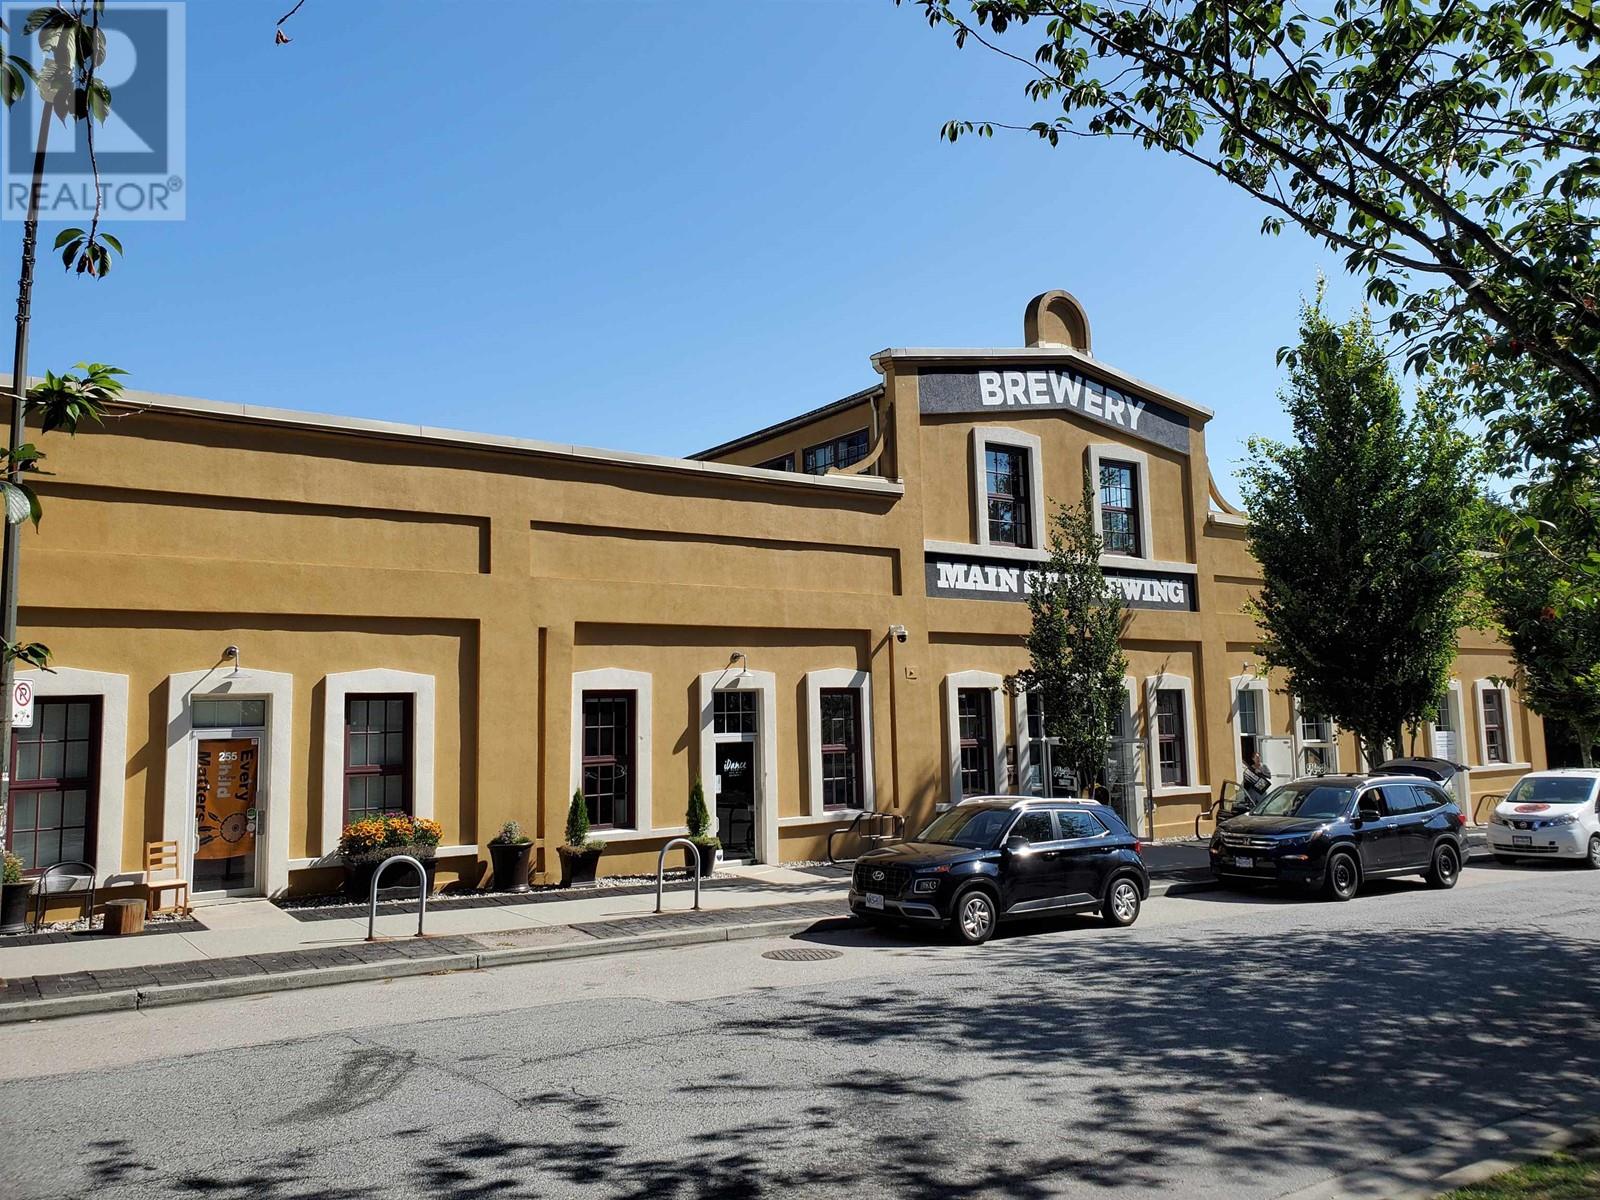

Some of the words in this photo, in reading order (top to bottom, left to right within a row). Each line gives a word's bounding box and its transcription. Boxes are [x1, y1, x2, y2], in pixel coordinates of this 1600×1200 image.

[978, 370, 1146, 430] BREWERY
[937, 562, 1020, 594] MAIN
[1065, 572, 1185, 603] EWING
[216, 752, 234, 798] hild
[218, 751, 238, 761] 255
[235, 750, 254, 800] Every
[196, 751, 212, 822] Matters
